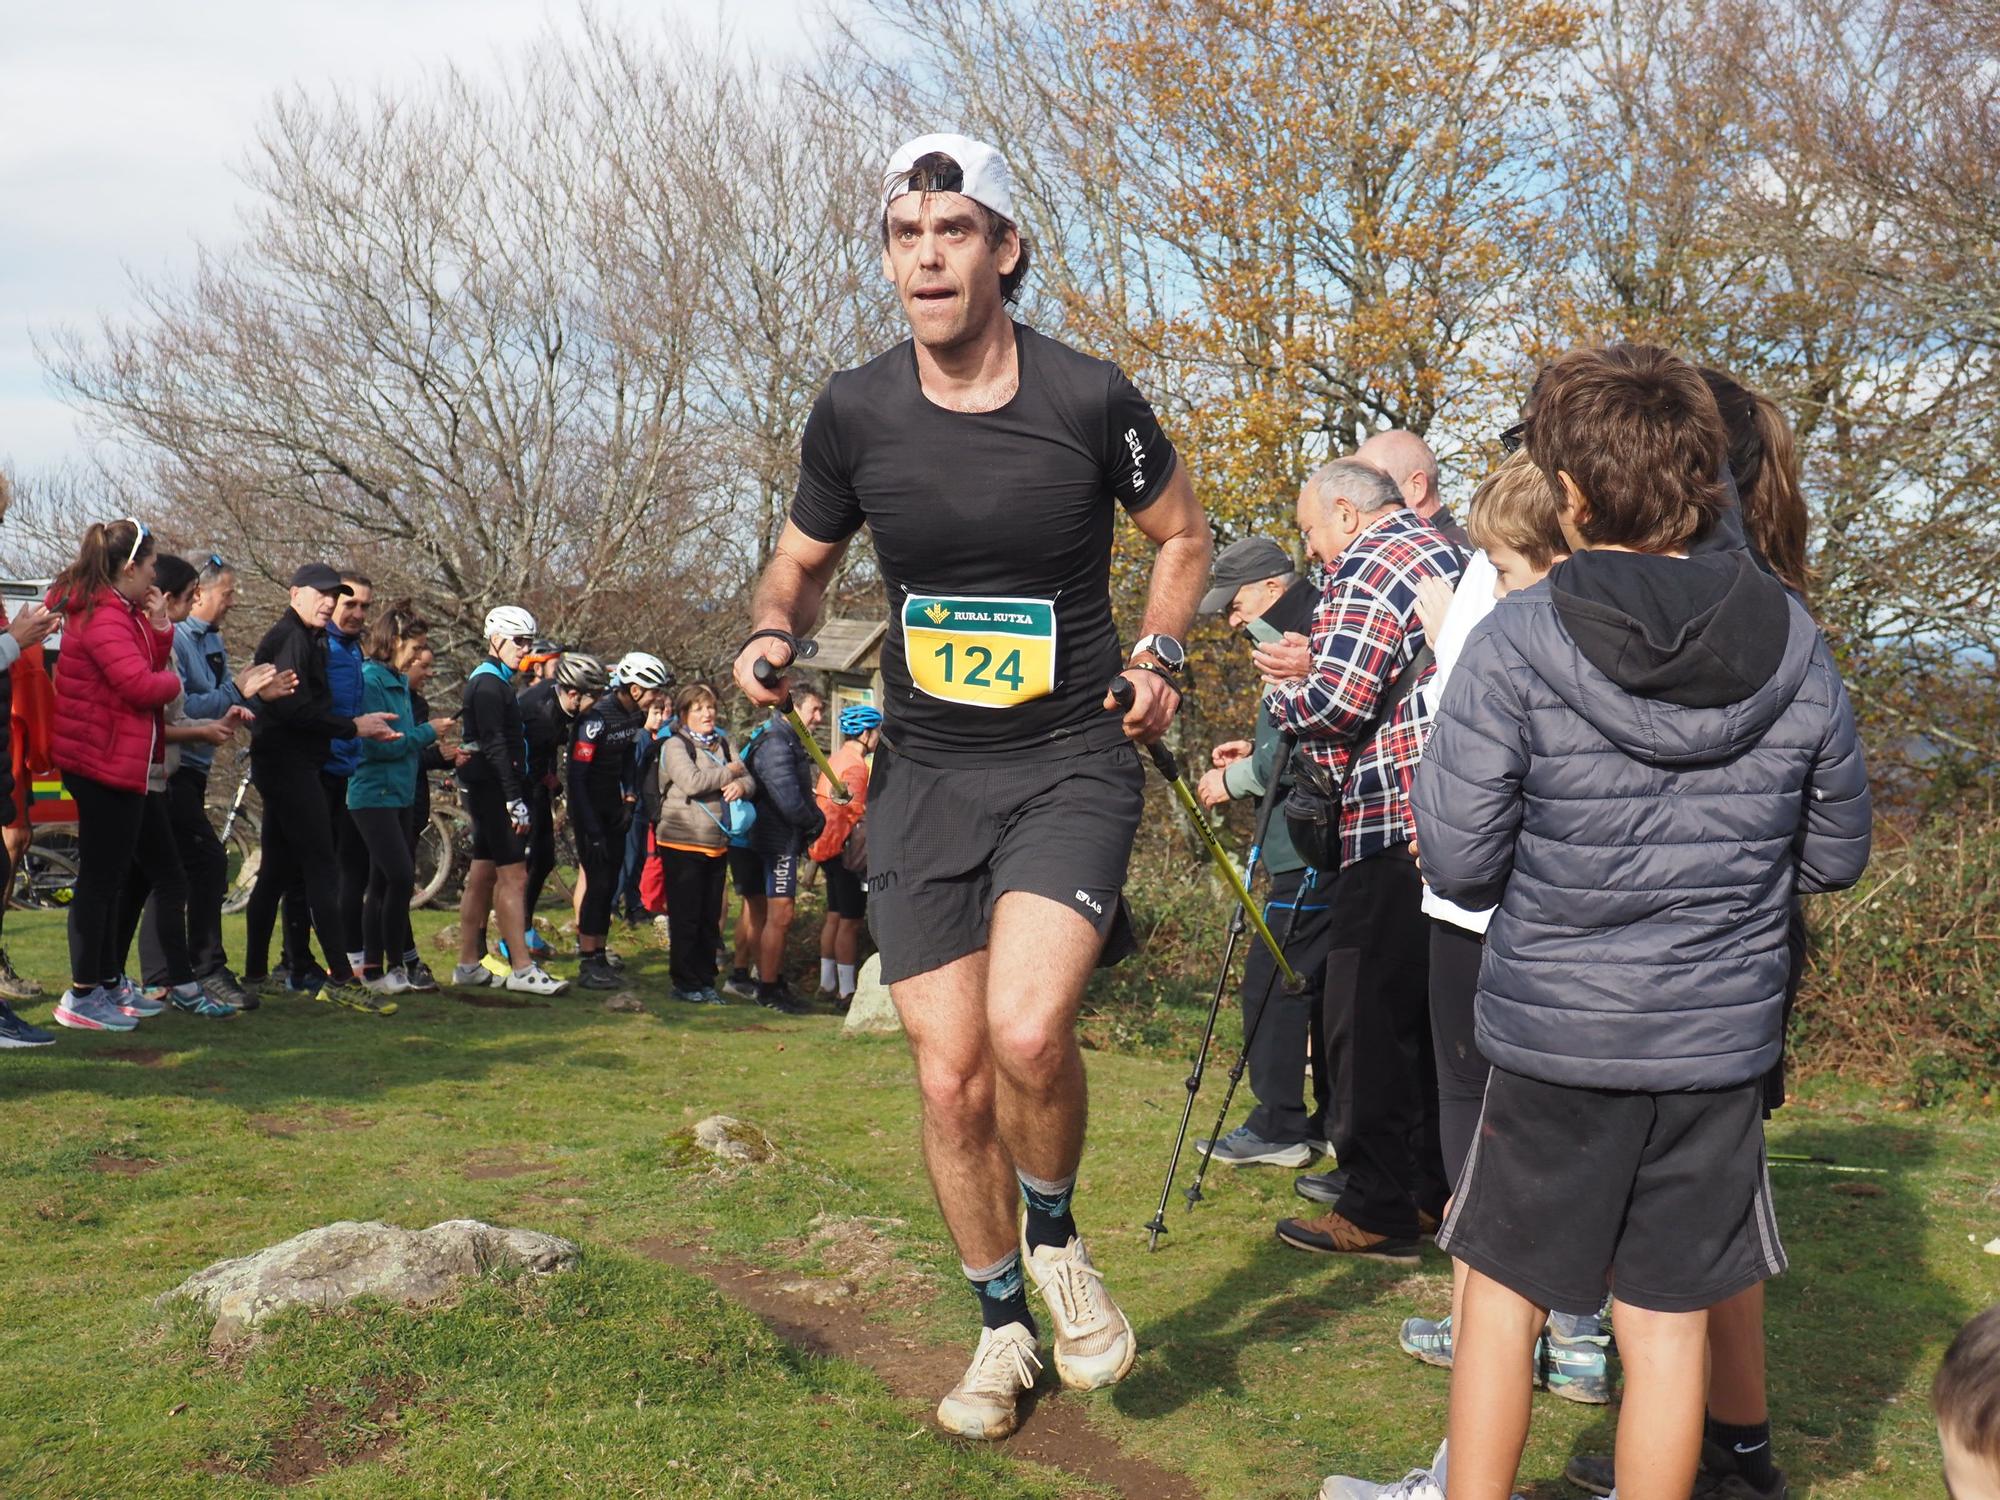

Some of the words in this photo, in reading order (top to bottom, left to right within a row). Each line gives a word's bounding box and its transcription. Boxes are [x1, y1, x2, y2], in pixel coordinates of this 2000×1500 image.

[954, 611, 991, 622] RURAL
[993, 611, 1034, 625] KUTXA
[934, 642, 1024, 691] 124
[773, 854, 793, 894] Azpiru
